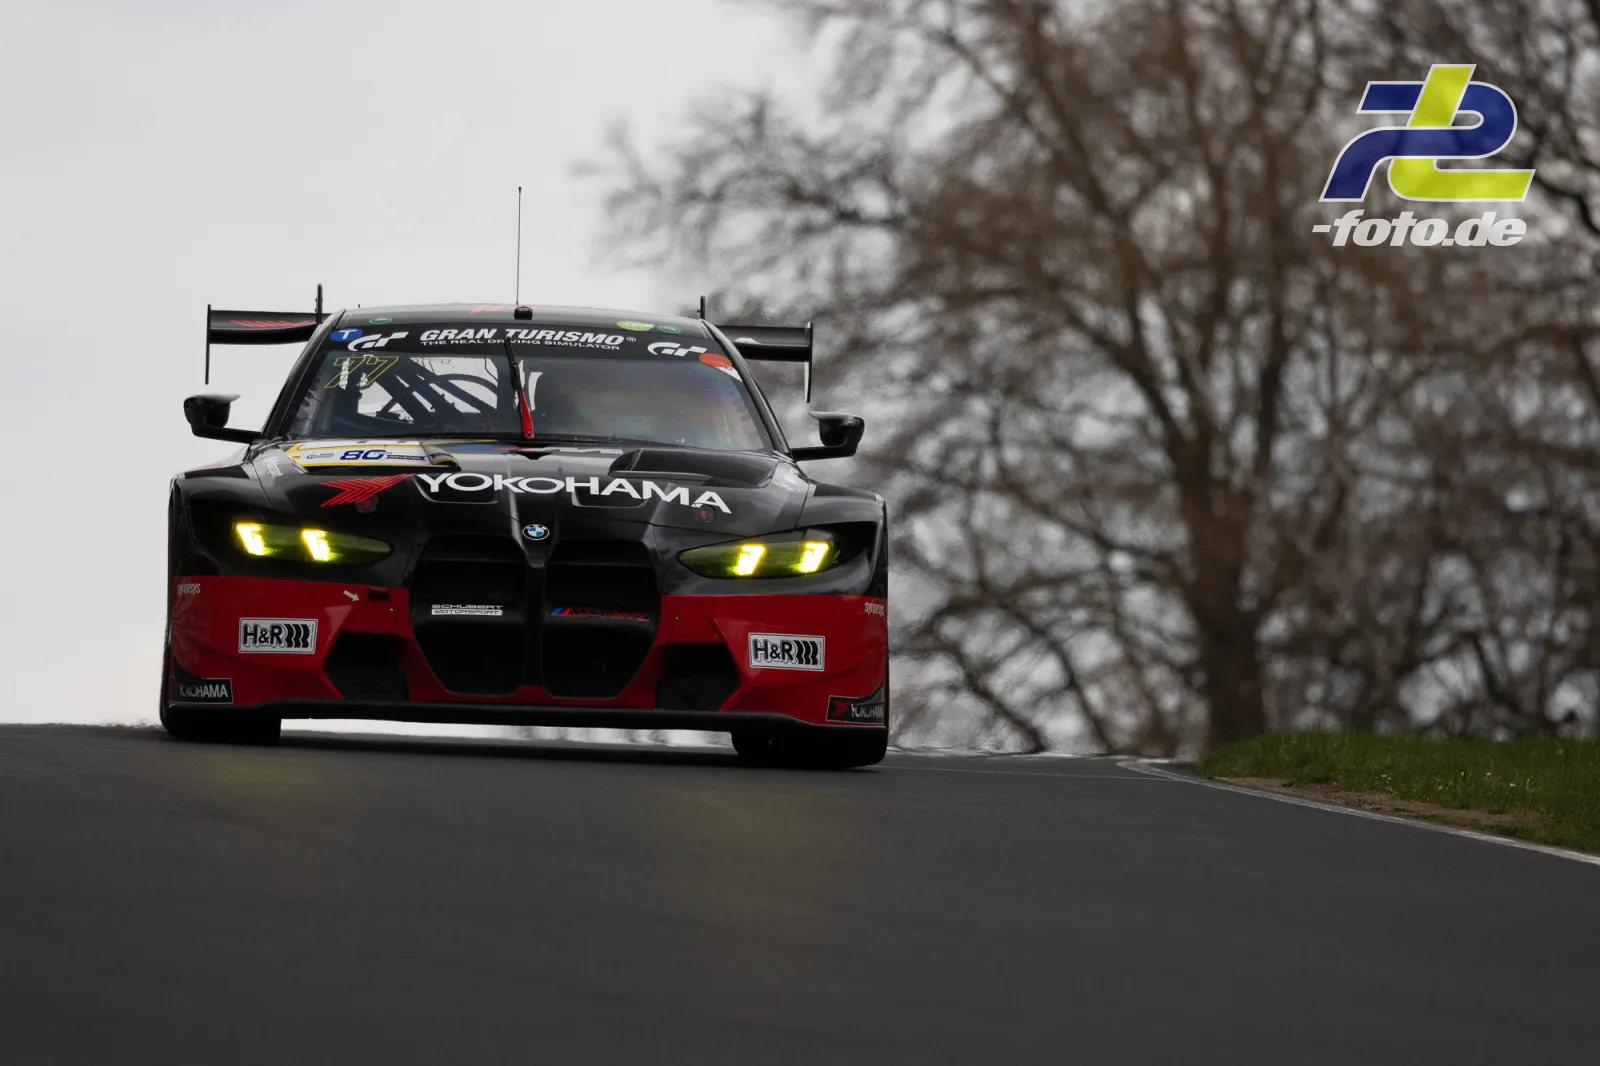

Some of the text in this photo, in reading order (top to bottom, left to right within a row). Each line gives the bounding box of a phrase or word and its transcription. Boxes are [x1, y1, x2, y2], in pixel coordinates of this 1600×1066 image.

[420, 328, 498, 341] GRAN
[544, 340, 620, 351] SIMULATOR
[340, 449, 387, 461] 80
[417, 473, 732, 514] YOKOHAMA
[243, 623, 286, 648] H&R
[752, 638, 797, 664] H&R
